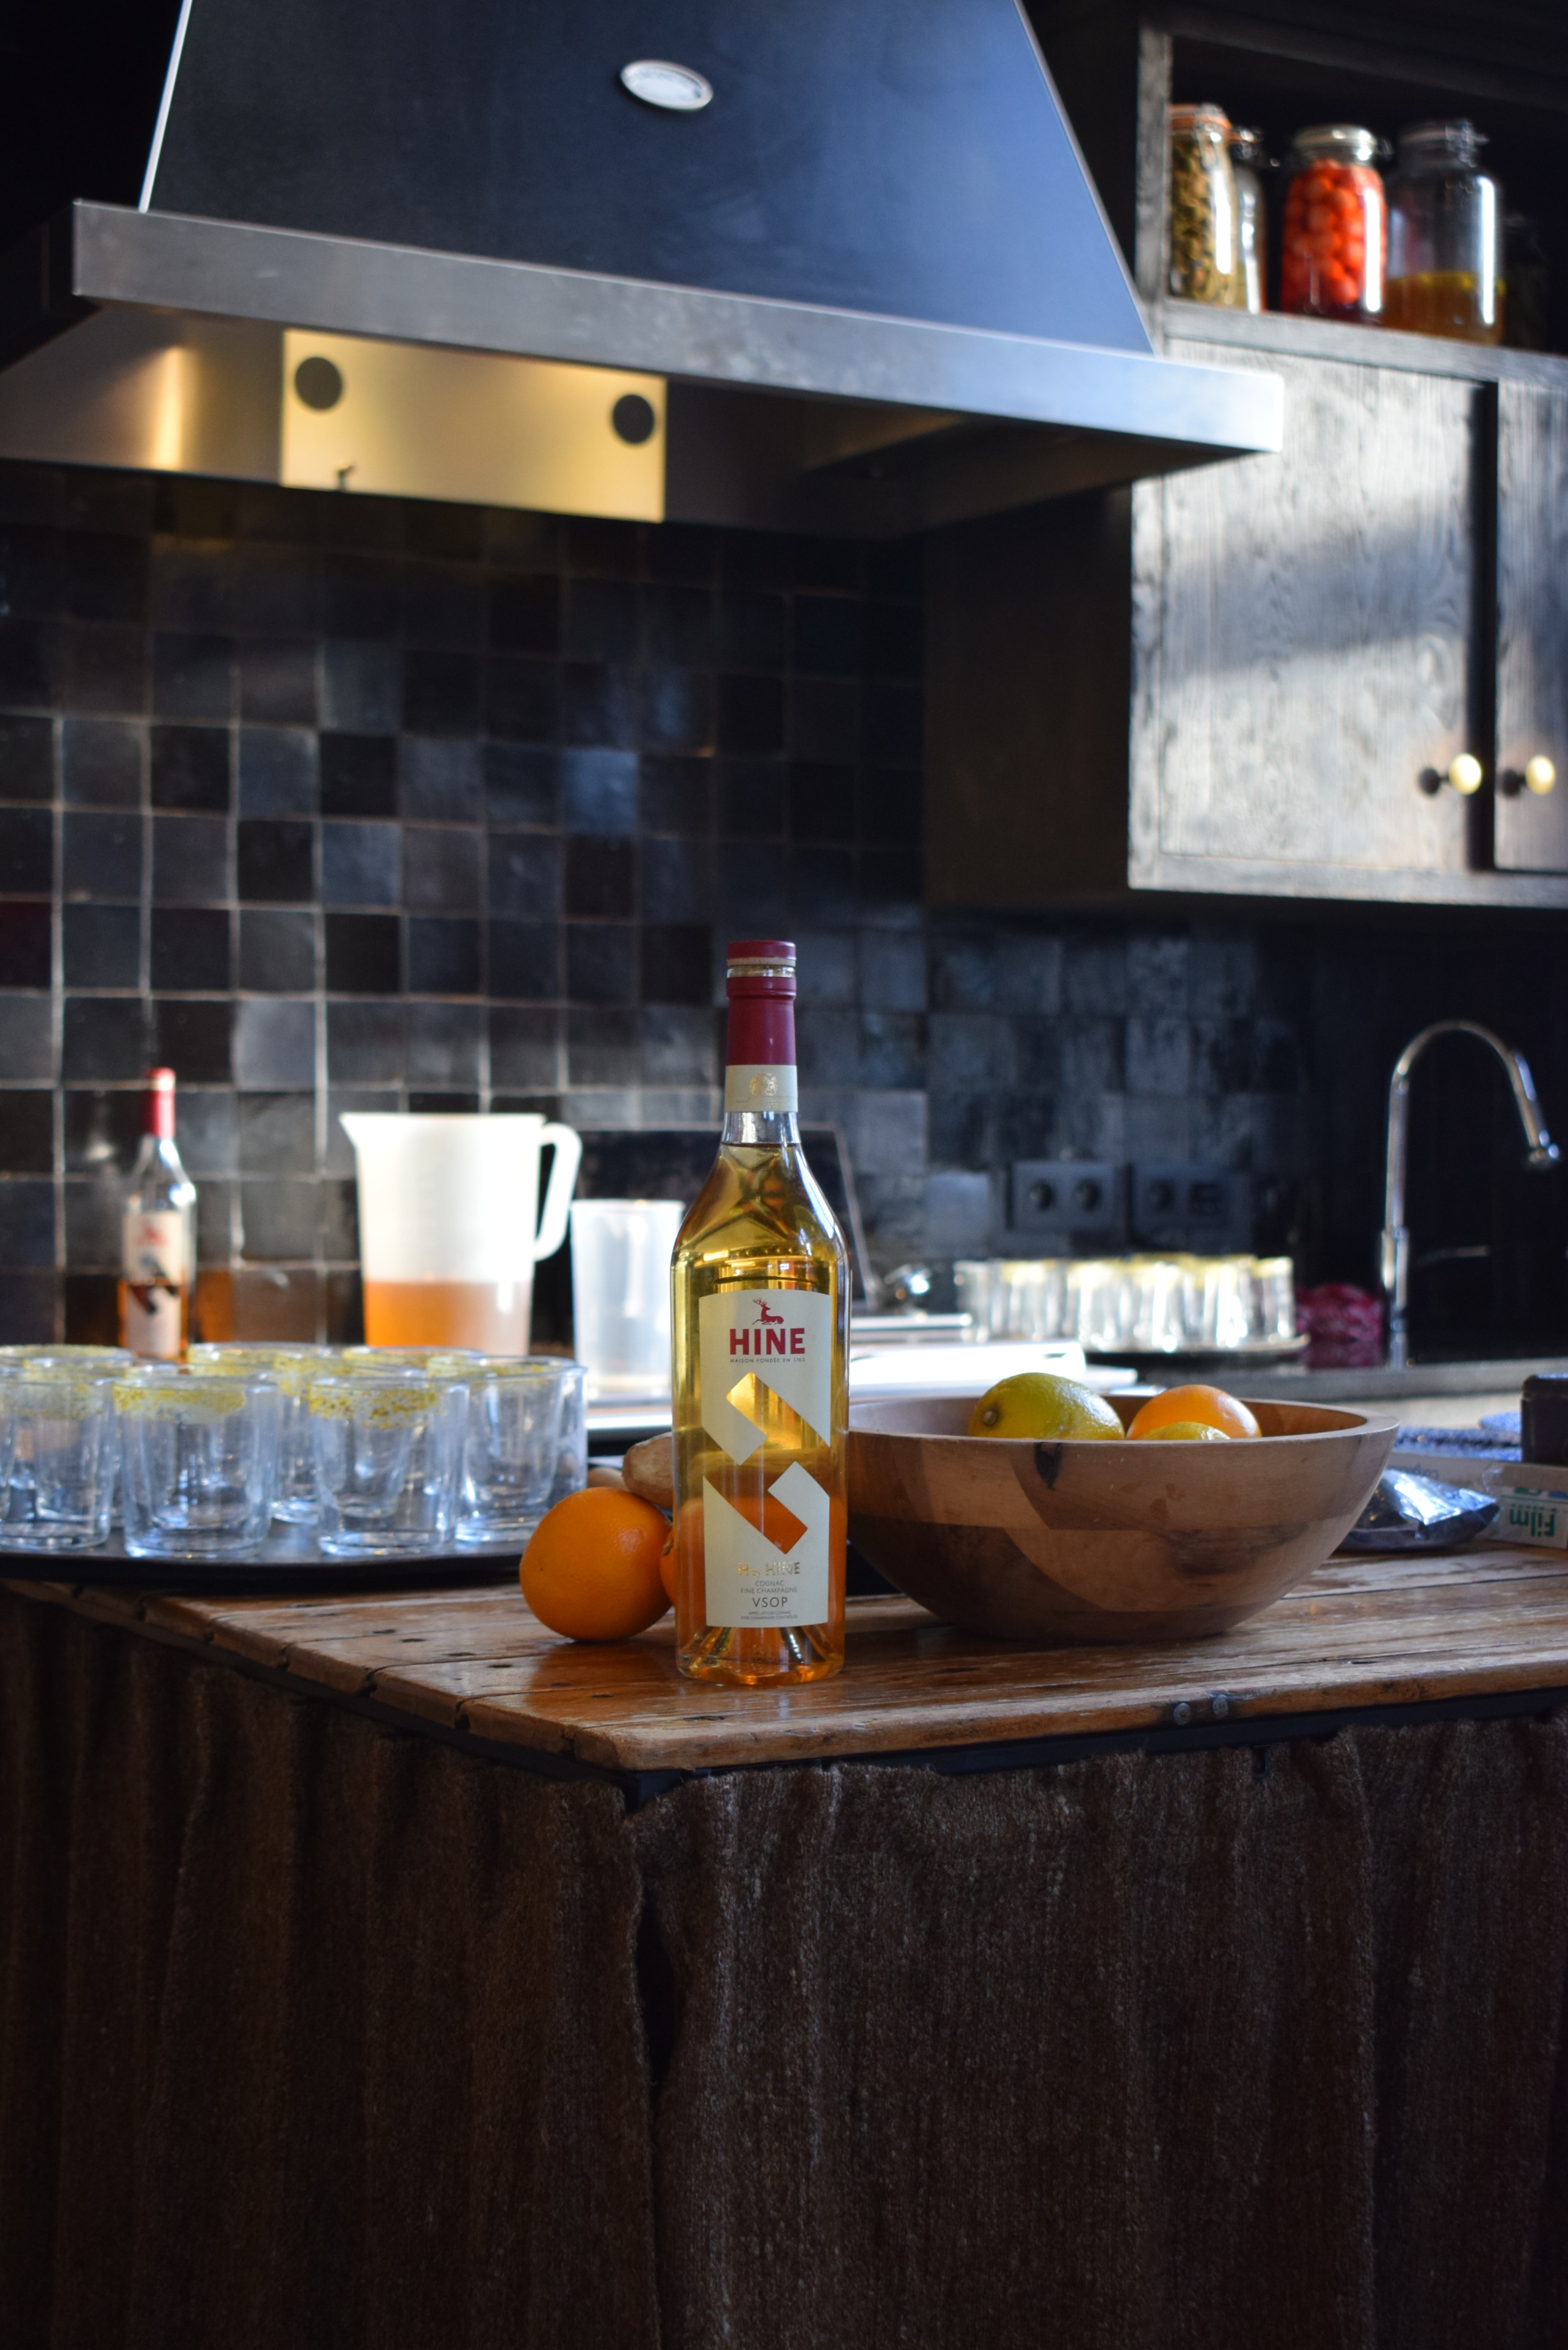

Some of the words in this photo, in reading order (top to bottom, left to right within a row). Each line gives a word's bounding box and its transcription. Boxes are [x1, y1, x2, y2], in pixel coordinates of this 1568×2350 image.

[730, 1328, 805, 1355] HINE
[1509, 1509, 1555, 1537] Film
[737, 1562, 749, 1576] H
[765, 1562, 800, 1575] HINE
[752, 1597, 788, 1608] VSOP
